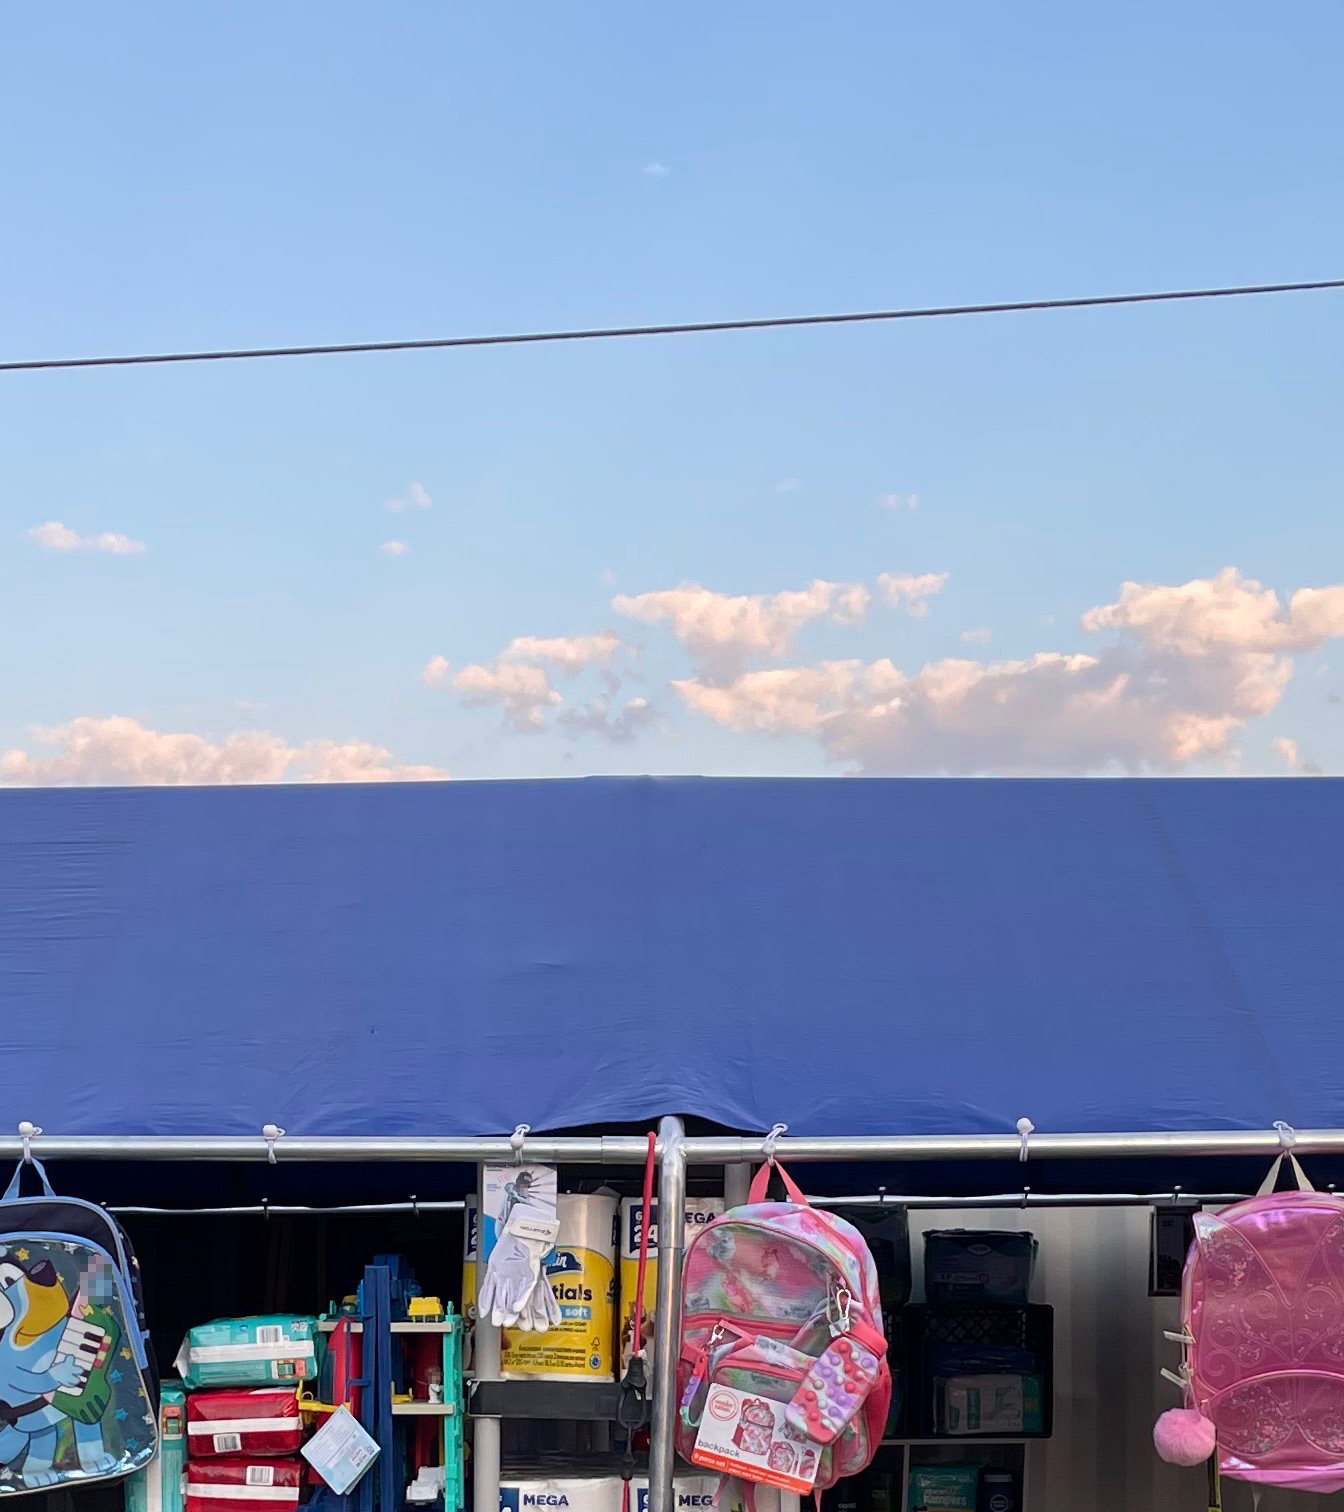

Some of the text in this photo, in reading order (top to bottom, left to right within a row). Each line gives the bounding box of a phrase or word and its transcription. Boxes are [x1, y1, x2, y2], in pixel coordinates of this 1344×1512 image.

[685, 1212, 716, 1223] EGA
[565, 1307, 589, 1318] soft
[697, 1439, 741, 1459] backpack
[523, 1494, 569, 1507] MEGA
[678, 1495, 712, 1507] MEG
